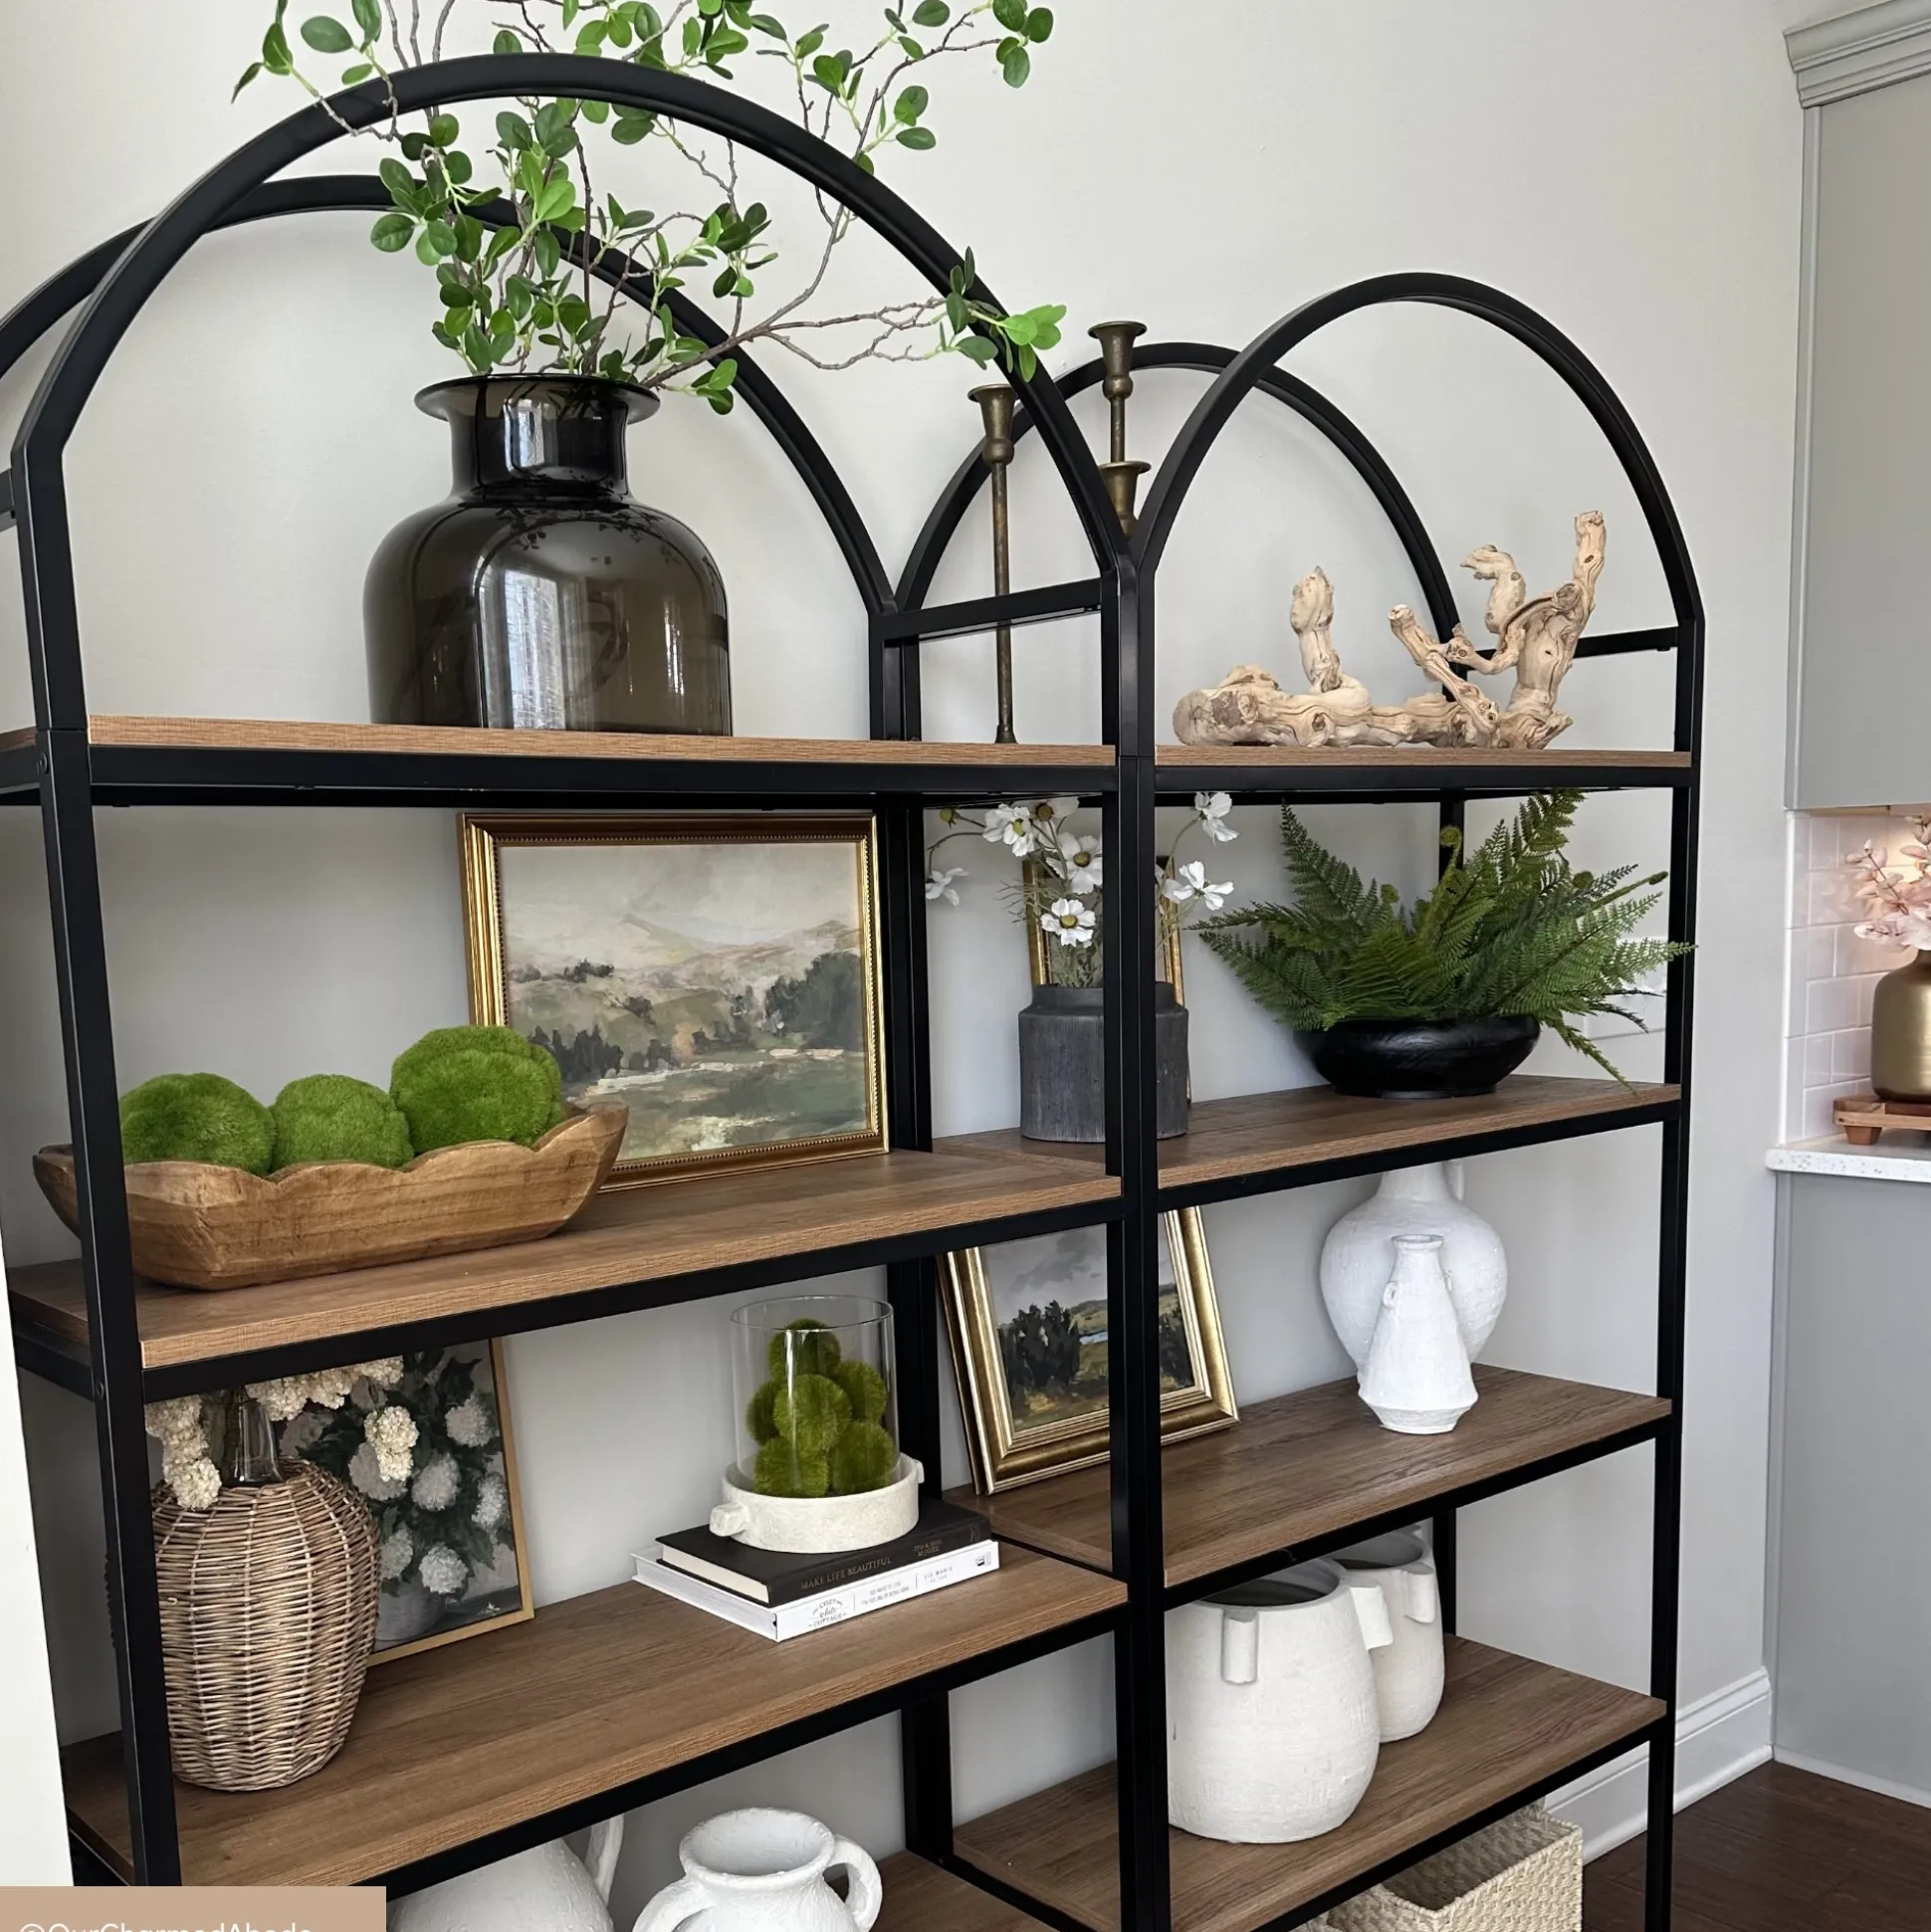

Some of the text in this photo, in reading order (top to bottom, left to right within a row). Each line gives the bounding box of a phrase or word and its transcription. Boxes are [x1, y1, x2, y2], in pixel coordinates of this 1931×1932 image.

[800, 1557, 892, 1590] MAKE LIFE BEAUTIFUL
